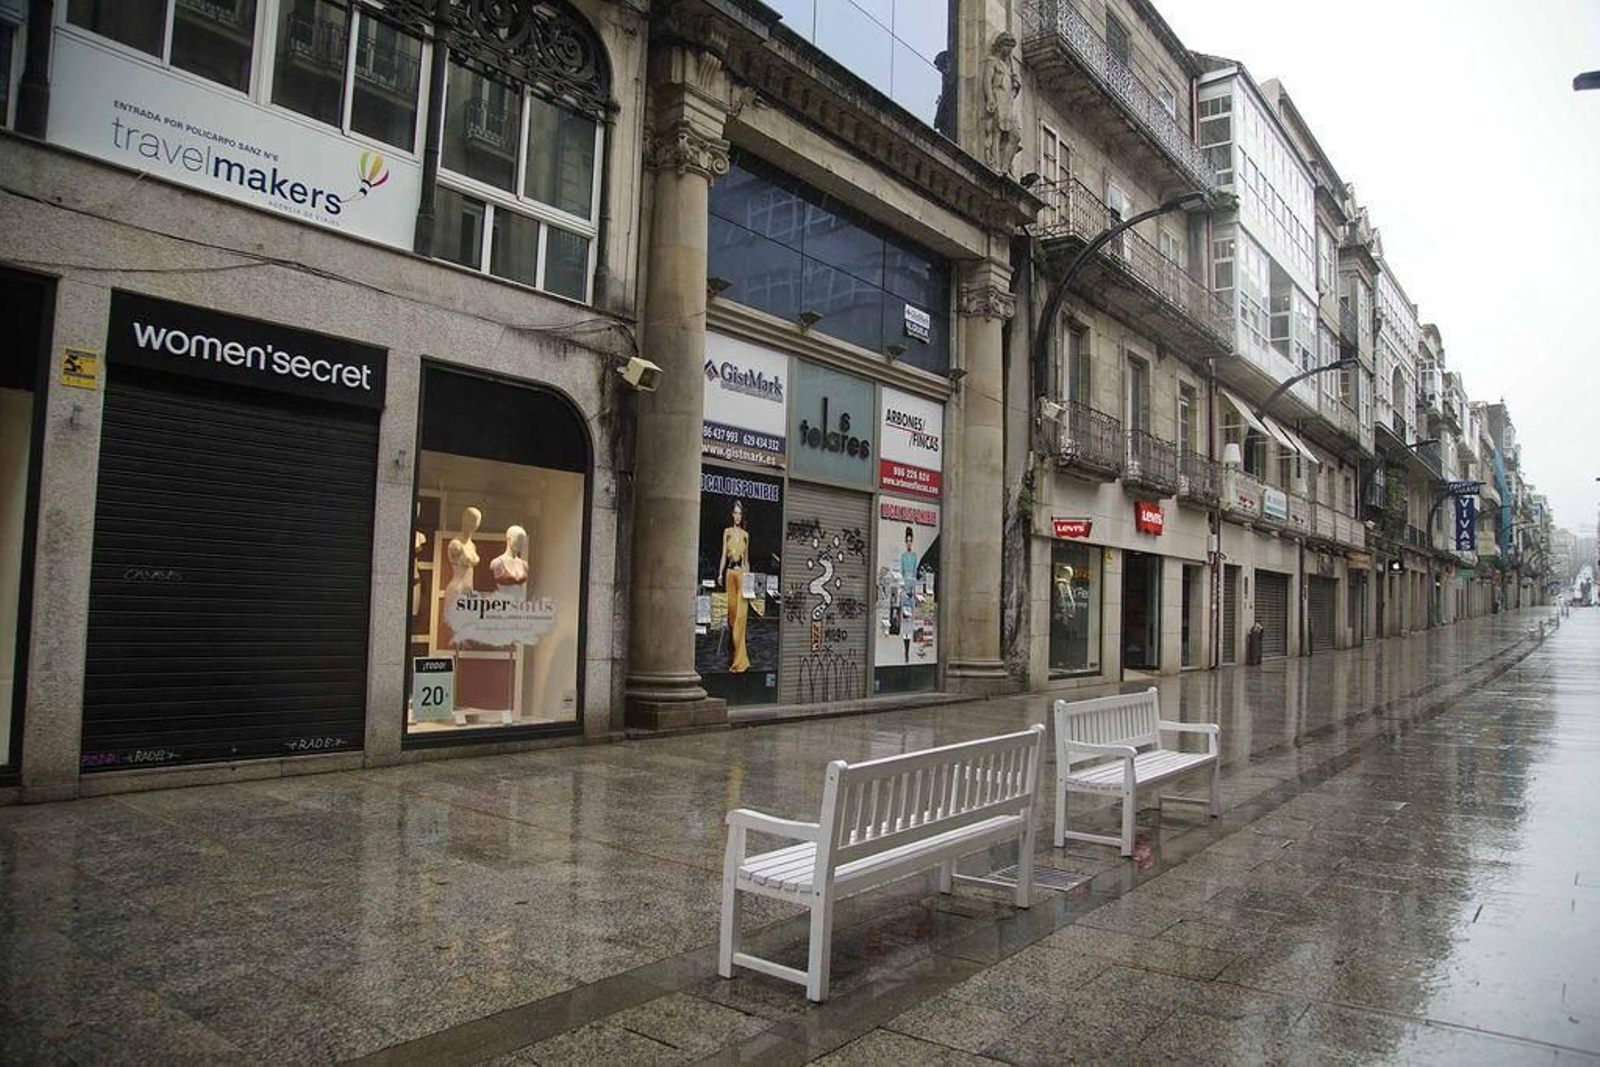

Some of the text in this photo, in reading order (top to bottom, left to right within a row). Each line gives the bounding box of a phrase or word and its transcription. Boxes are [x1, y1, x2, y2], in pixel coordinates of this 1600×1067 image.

[114, 100, 161, 123] ENTRADA
[164, 117, 184, 129] POR
[186, 123, 236, 148] POLICARPO
[238, 143, 262, 157] SANZ
[133, 322, 371, 390] women'secret
[720, 361, 783, 397] GistMark
[1460, 499, 1471, 550] VIVAS
[421, 686, 444, 707] 20
